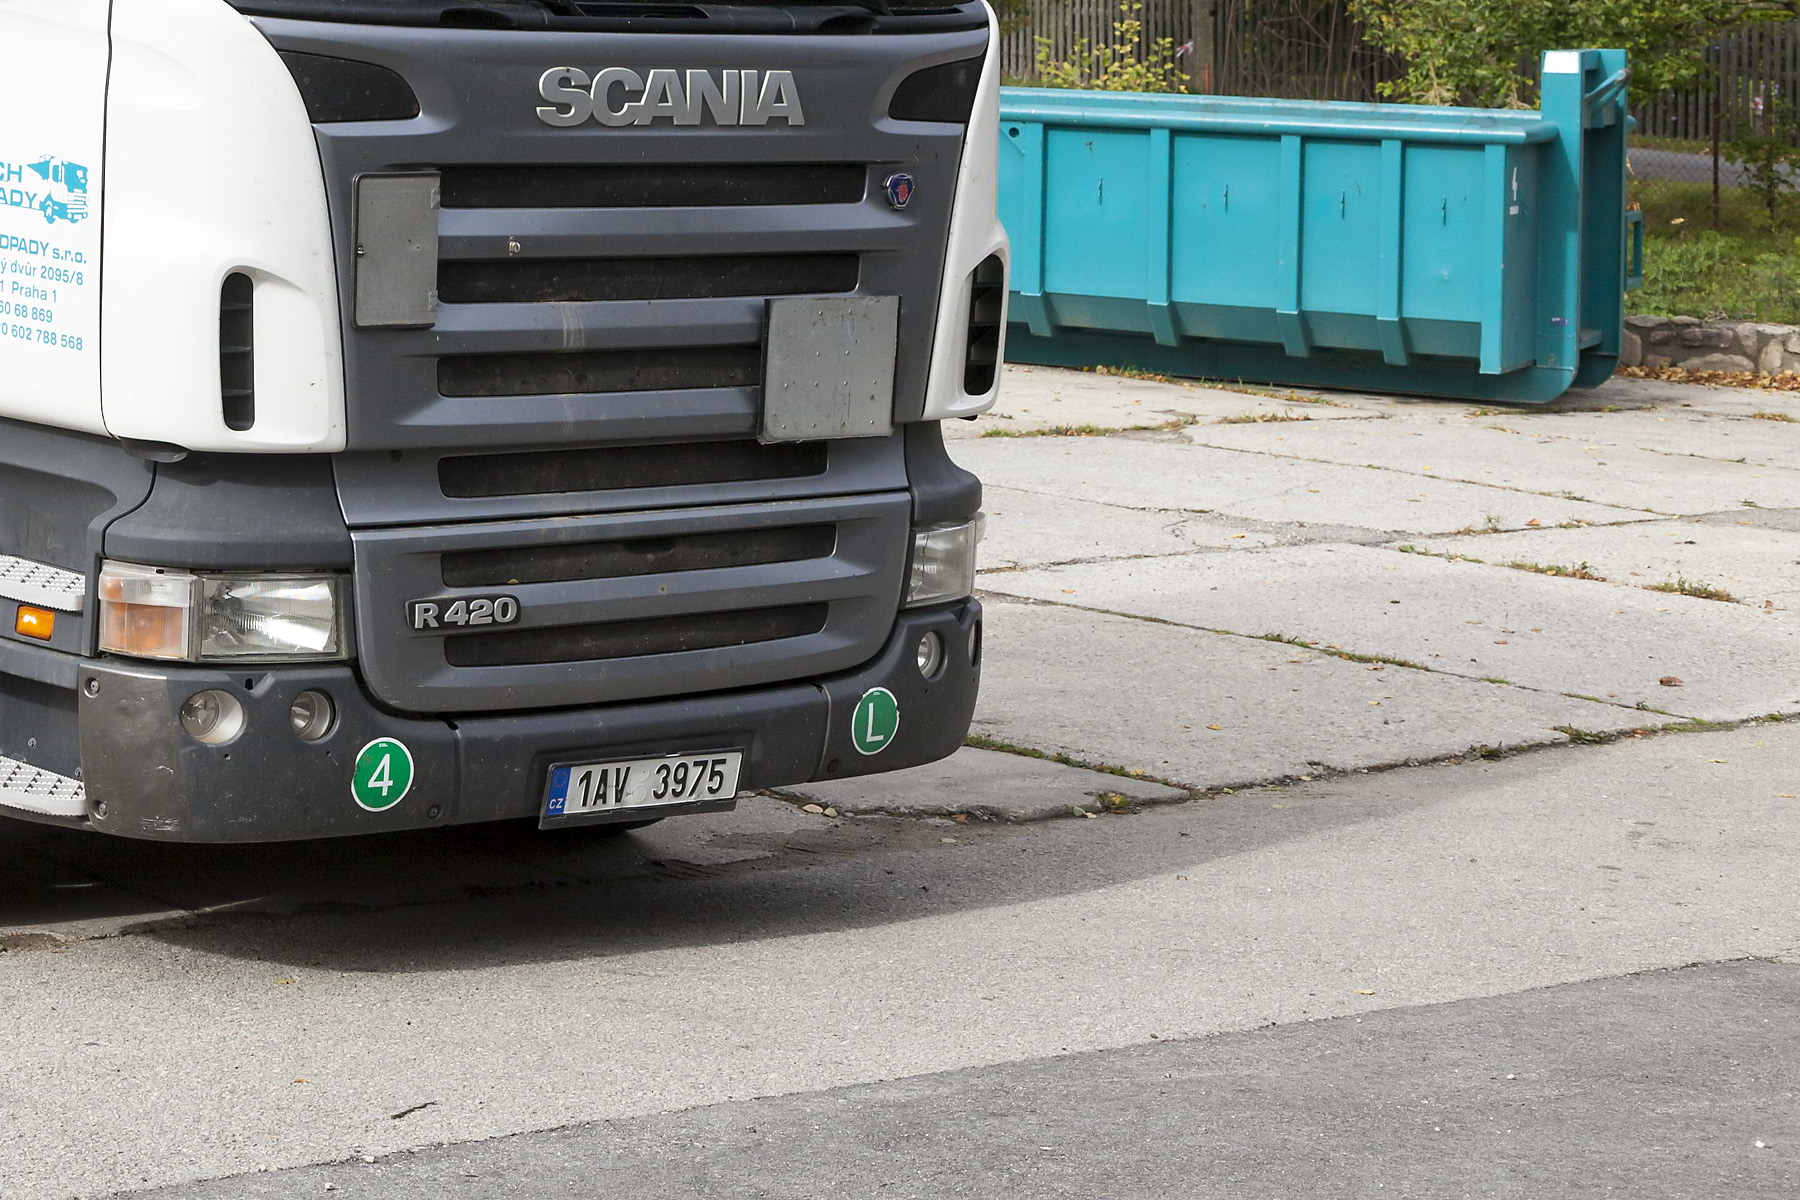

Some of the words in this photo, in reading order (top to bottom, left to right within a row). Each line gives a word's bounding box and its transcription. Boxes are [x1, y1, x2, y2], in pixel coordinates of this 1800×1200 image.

[535, 66, 805, 127] SCANIA
[52, 247, 87, 265] s.r.o.
[40, 265, 84, 286] 2095/8
[11, 280, 48, 301] Praha
[51, 289, 58, 303] 1
[14, 303, 28, 319] 68
[31, 306, 54, 323] 869
[11, 324, 32, 341] 602
[35, 328, 58, 346] 788
[60, 334, 83, 352] 568
[414, 602, 440, 629] R
[444, 597, 518, 626] 420
[865, 702, 885, 743] L
[367, 753, 394, 797] 4
[576, 766, 631, 808] 1AV
[652, 758, 727, 800] 3975
[549, 798, 563, 811] CZ
